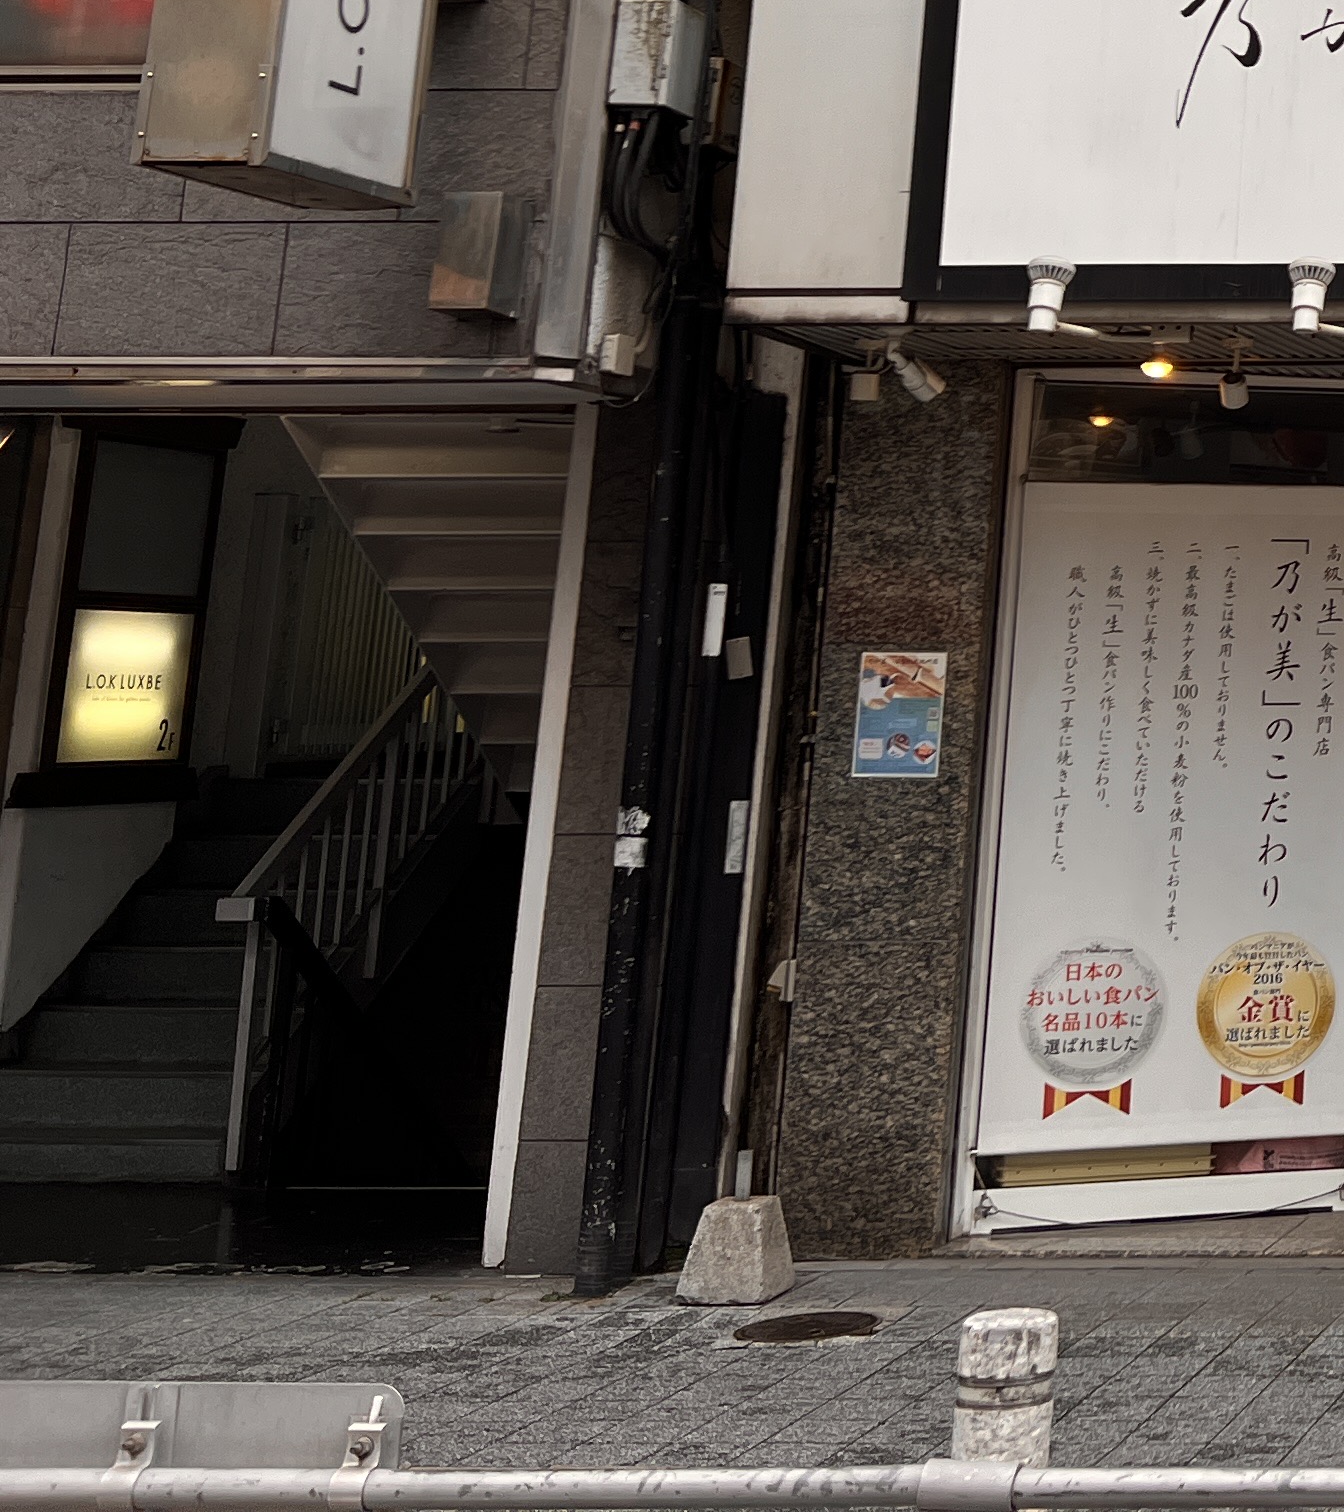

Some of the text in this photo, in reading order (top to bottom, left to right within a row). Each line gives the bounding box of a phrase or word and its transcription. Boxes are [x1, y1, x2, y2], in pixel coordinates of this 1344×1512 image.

[1312, 543, 1344, 757] 高級「生」食パン専門店
[120, 674, 162, 690] LUXBE
[157, 718, 176, 751] 2F
[1258, 538, 1310, 908] 「乃が美」のこだわり
[1065, 962, 1123, 982] 日本の
[1253, 973, 1283, 985] 2016
[1027, 985, 1160, 1008] おいしい食パン
[1237, 994, 1310, 1023] 金賞に
[1042, 1010, 1143, 1033] 名品10本に
[1225, 1025, 1310, 1042] 選ばれました
[1044, 1035, 1139, 1056] 選ばれました
